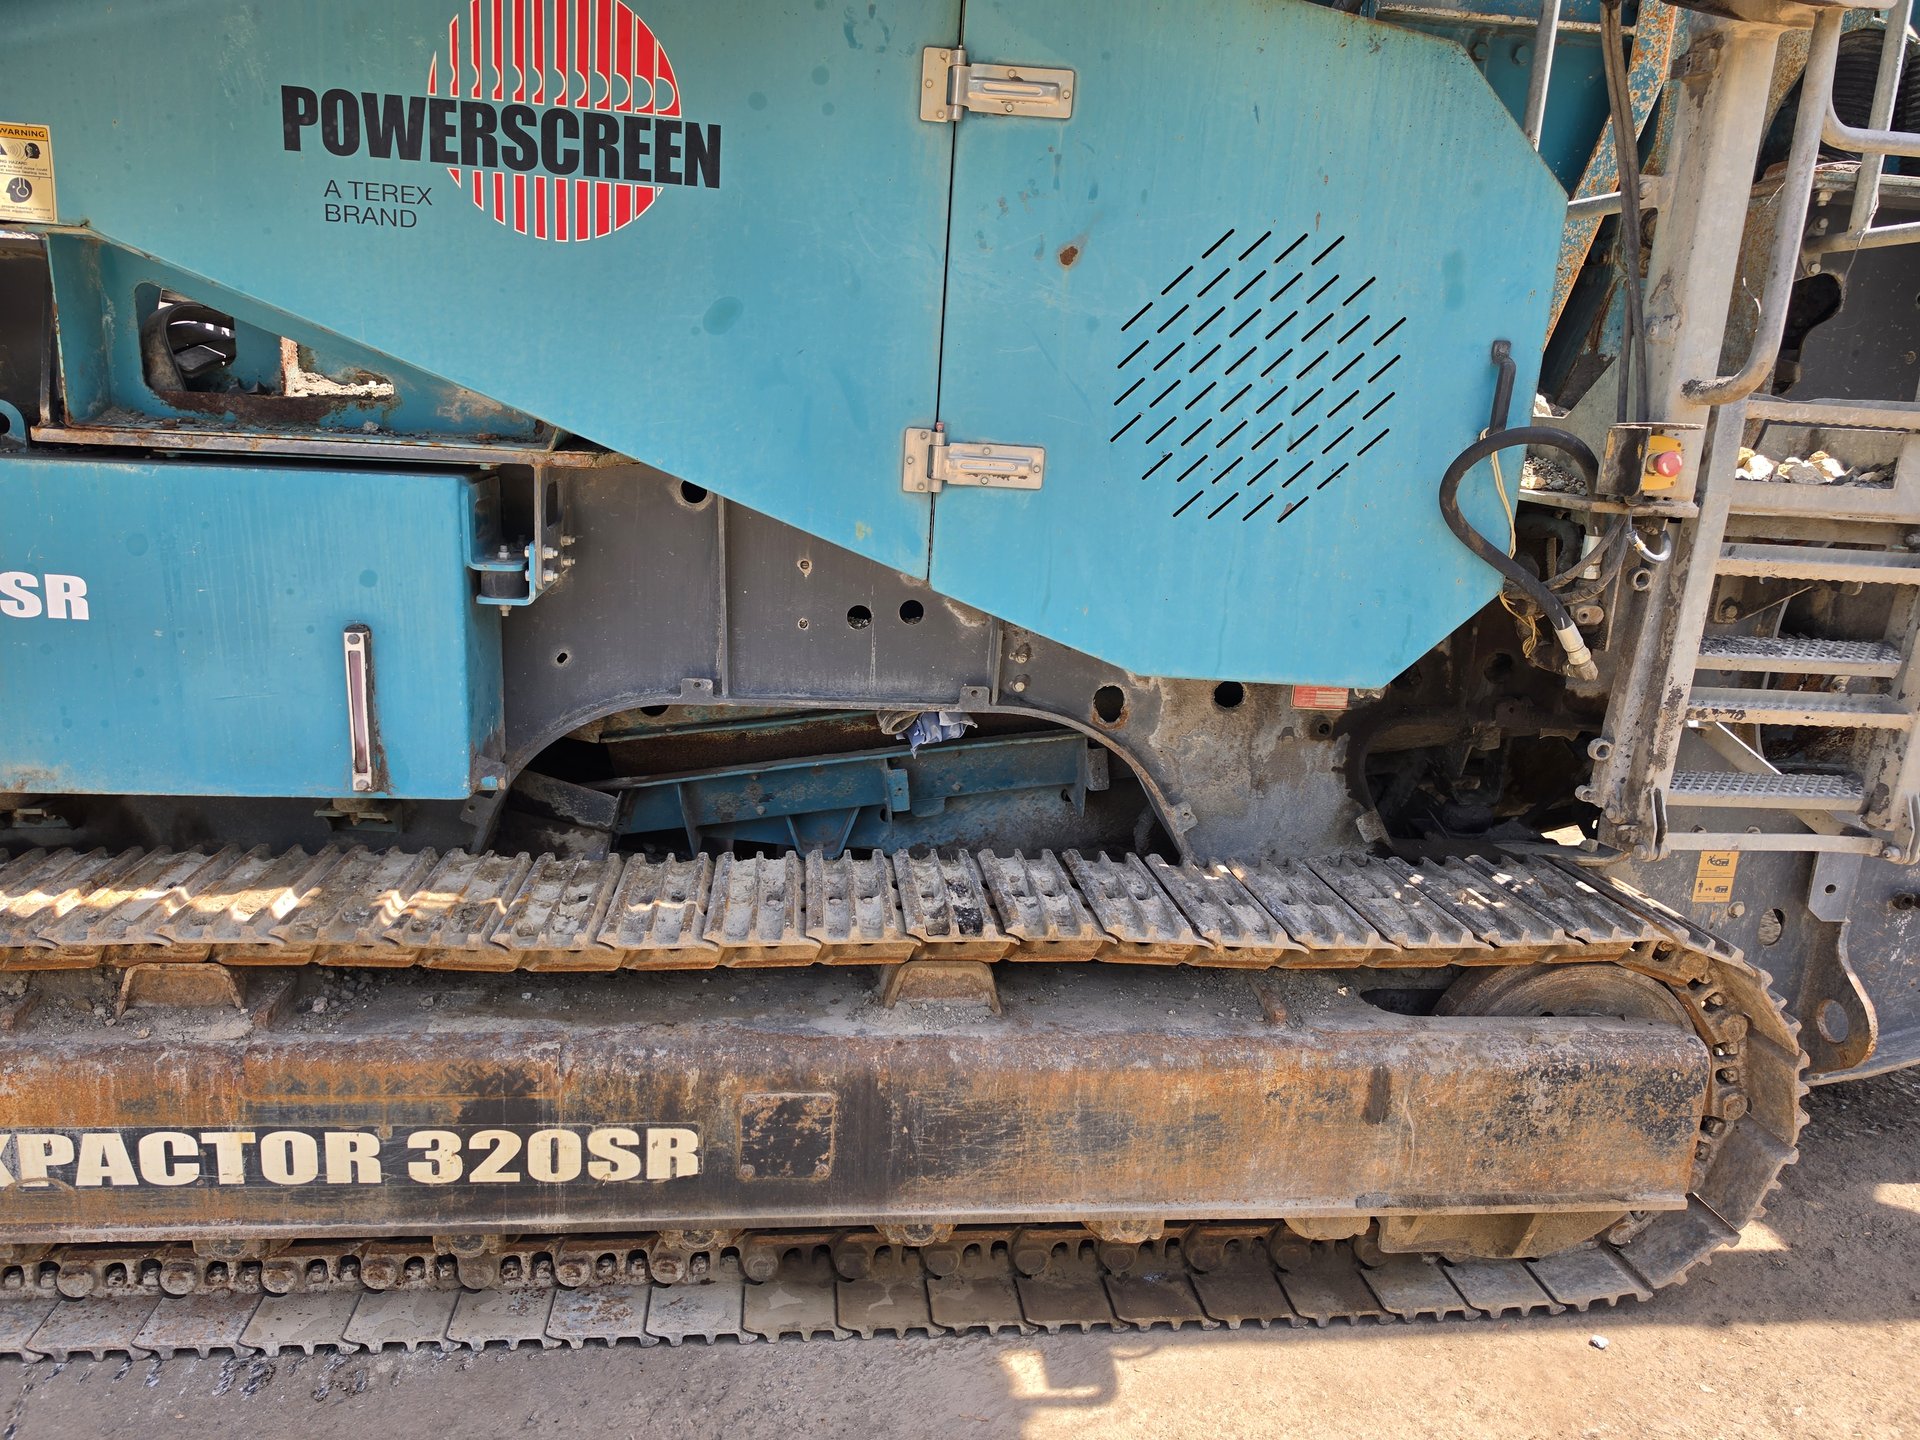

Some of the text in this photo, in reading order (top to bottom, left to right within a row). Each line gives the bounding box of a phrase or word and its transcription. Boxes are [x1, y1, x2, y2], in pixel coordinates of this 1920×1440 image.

[0, 127, 45, 138] WARNING
[280, 85, 722, 189] POWERSCREEN
[324, 179, 433, 206] A TEREX
[325, 203, 417, 228] BRAND
[0, 571, 89, 621] SR
[407, 1128, 700, 1184] 320SR
